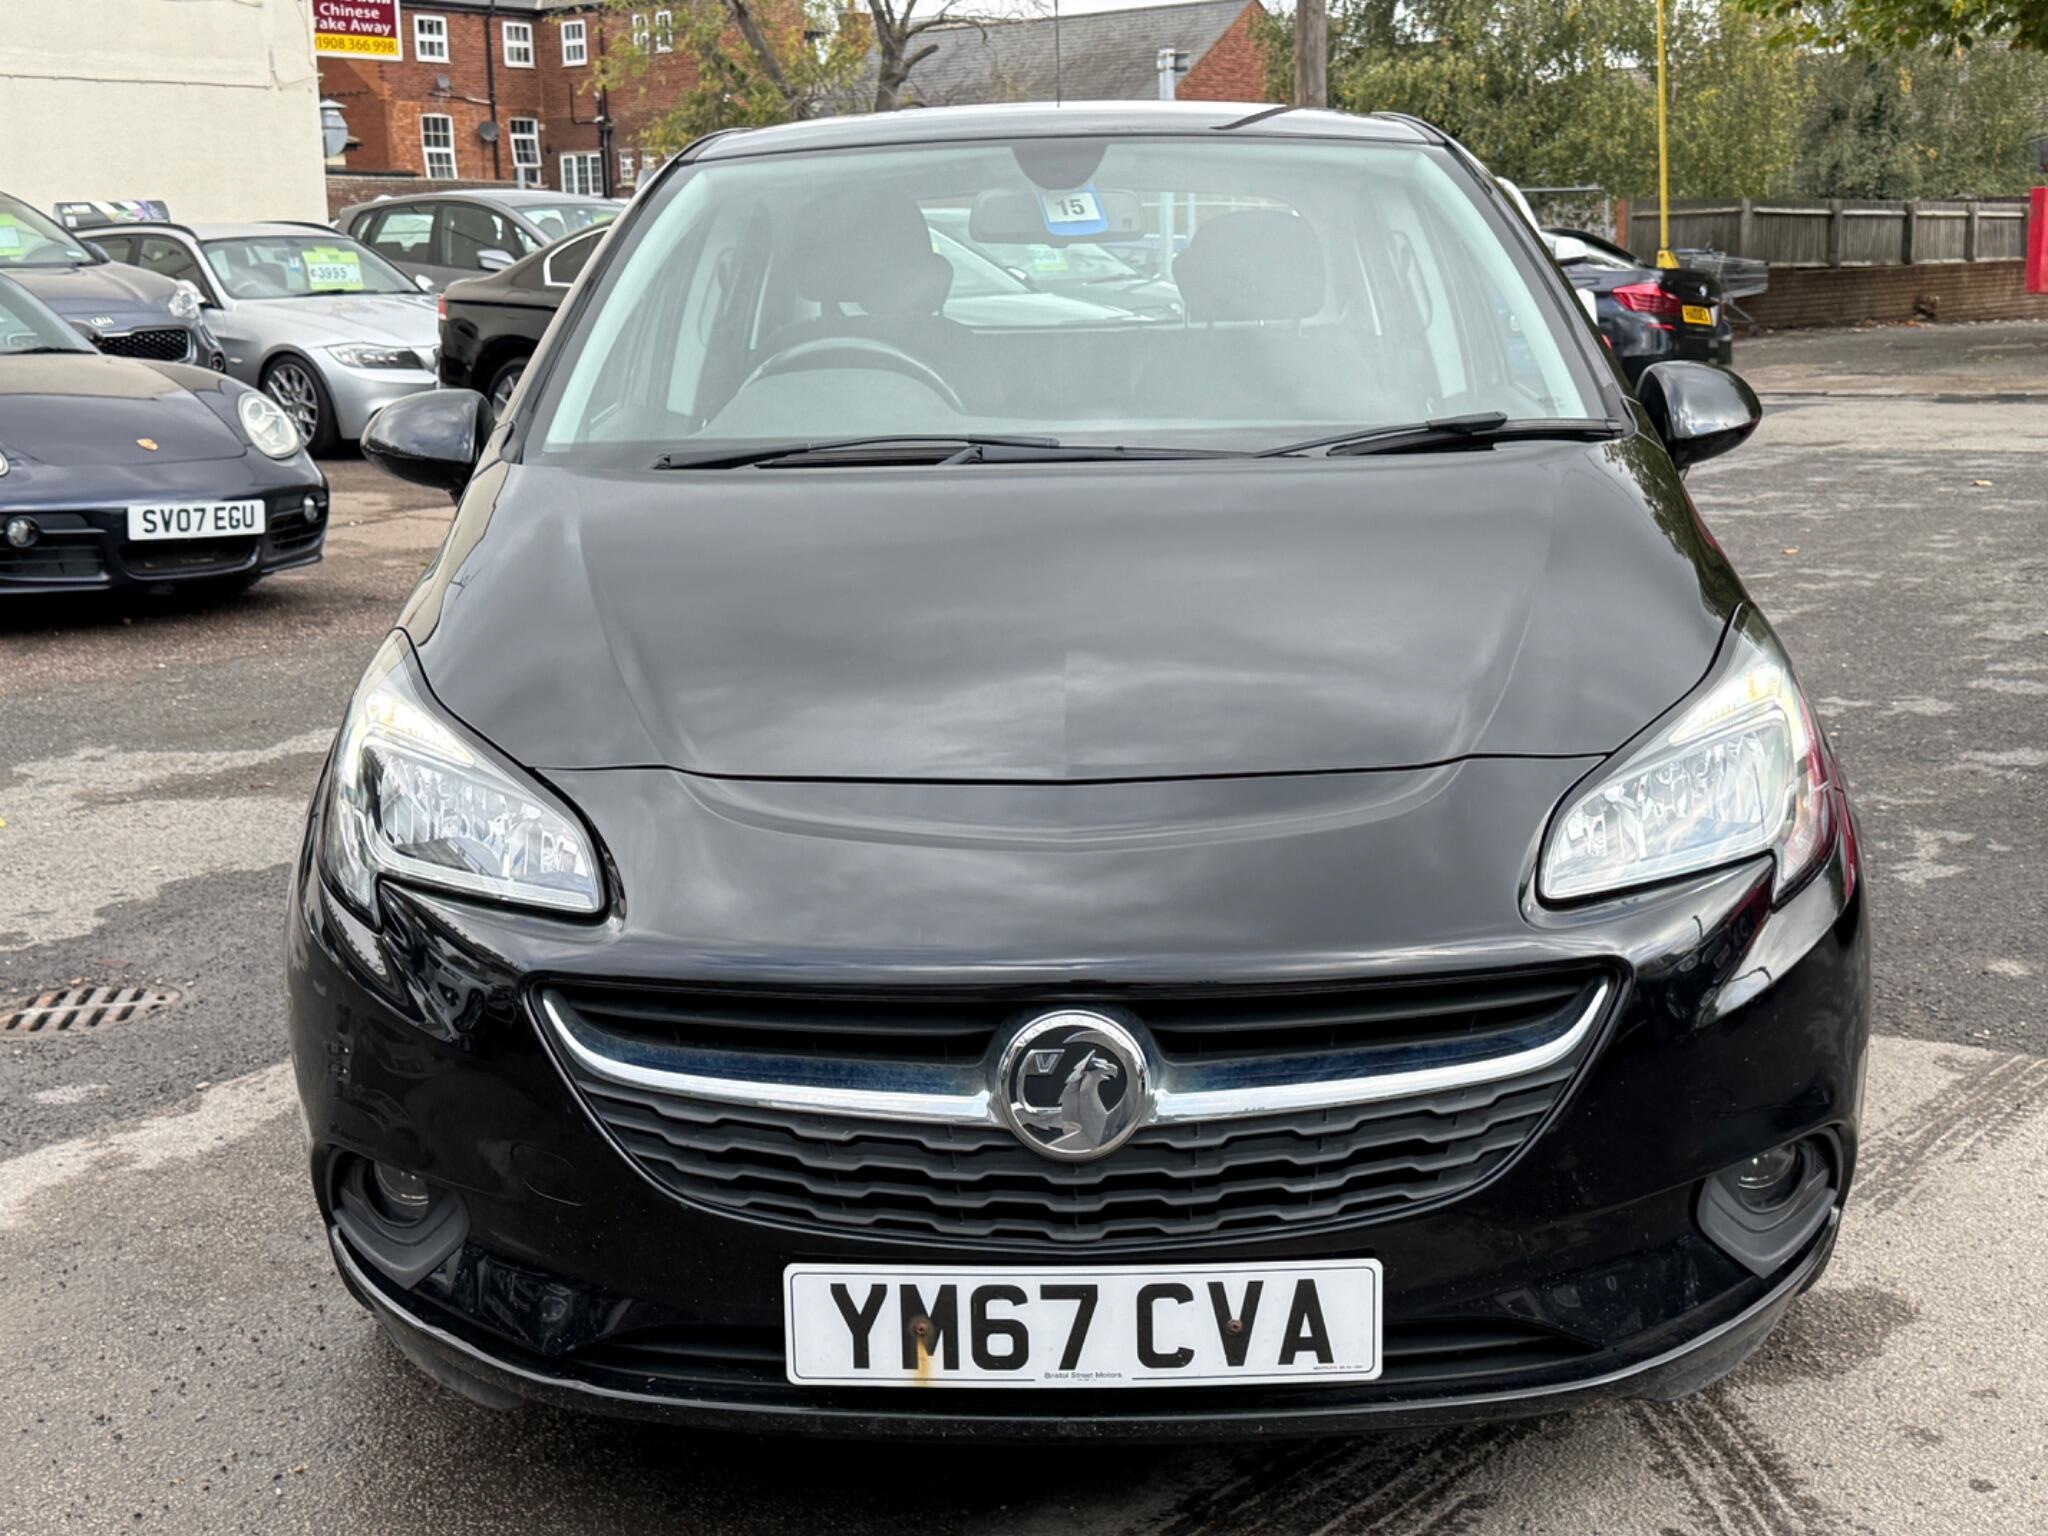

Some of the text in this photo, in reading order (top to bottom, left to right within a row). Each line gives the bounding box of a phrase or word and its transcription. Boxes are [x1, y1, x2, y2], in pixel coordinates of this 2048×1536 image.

[319, 2, 380, 19] Chinese
[350, 19, 391, 36] Away
[315, 36, 395, 53] 1908 366 998
[1056, 198, 1085, 216] 15
[142, 504, 255, 534] SV07 EGU
[830, 1278, 1334, 1371] YM67 CVA
[1044, 1371, 1122, 1379] Bristol Street Motors
